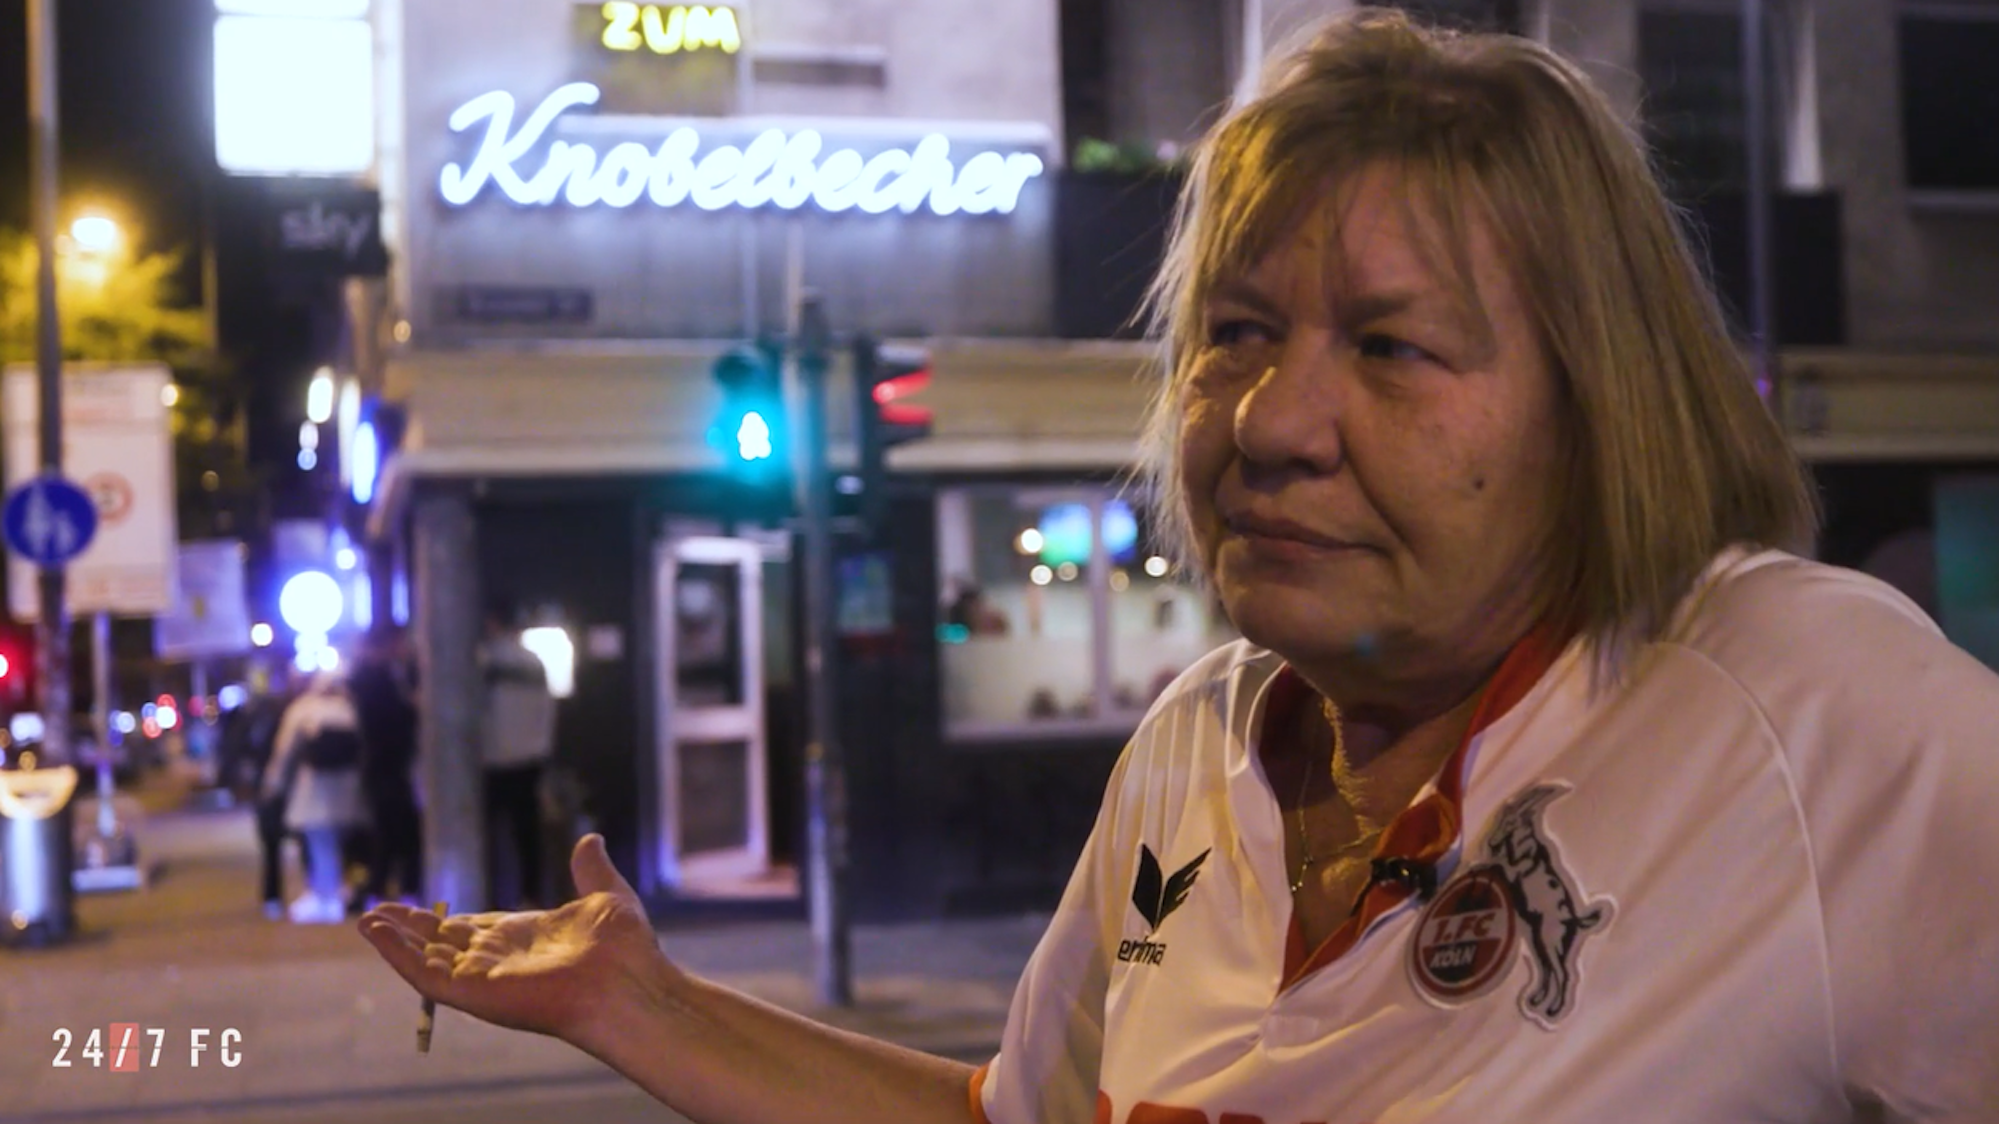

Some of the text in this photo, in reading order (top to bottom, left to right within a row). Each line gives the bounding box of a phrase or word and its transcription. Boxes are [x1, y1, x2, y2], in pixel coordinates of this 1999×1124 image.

[601, 1, 741, 54] ZUM
[440, 82, 1043, 214] Knobelbecher
[281, 201, 372, 259] sky
